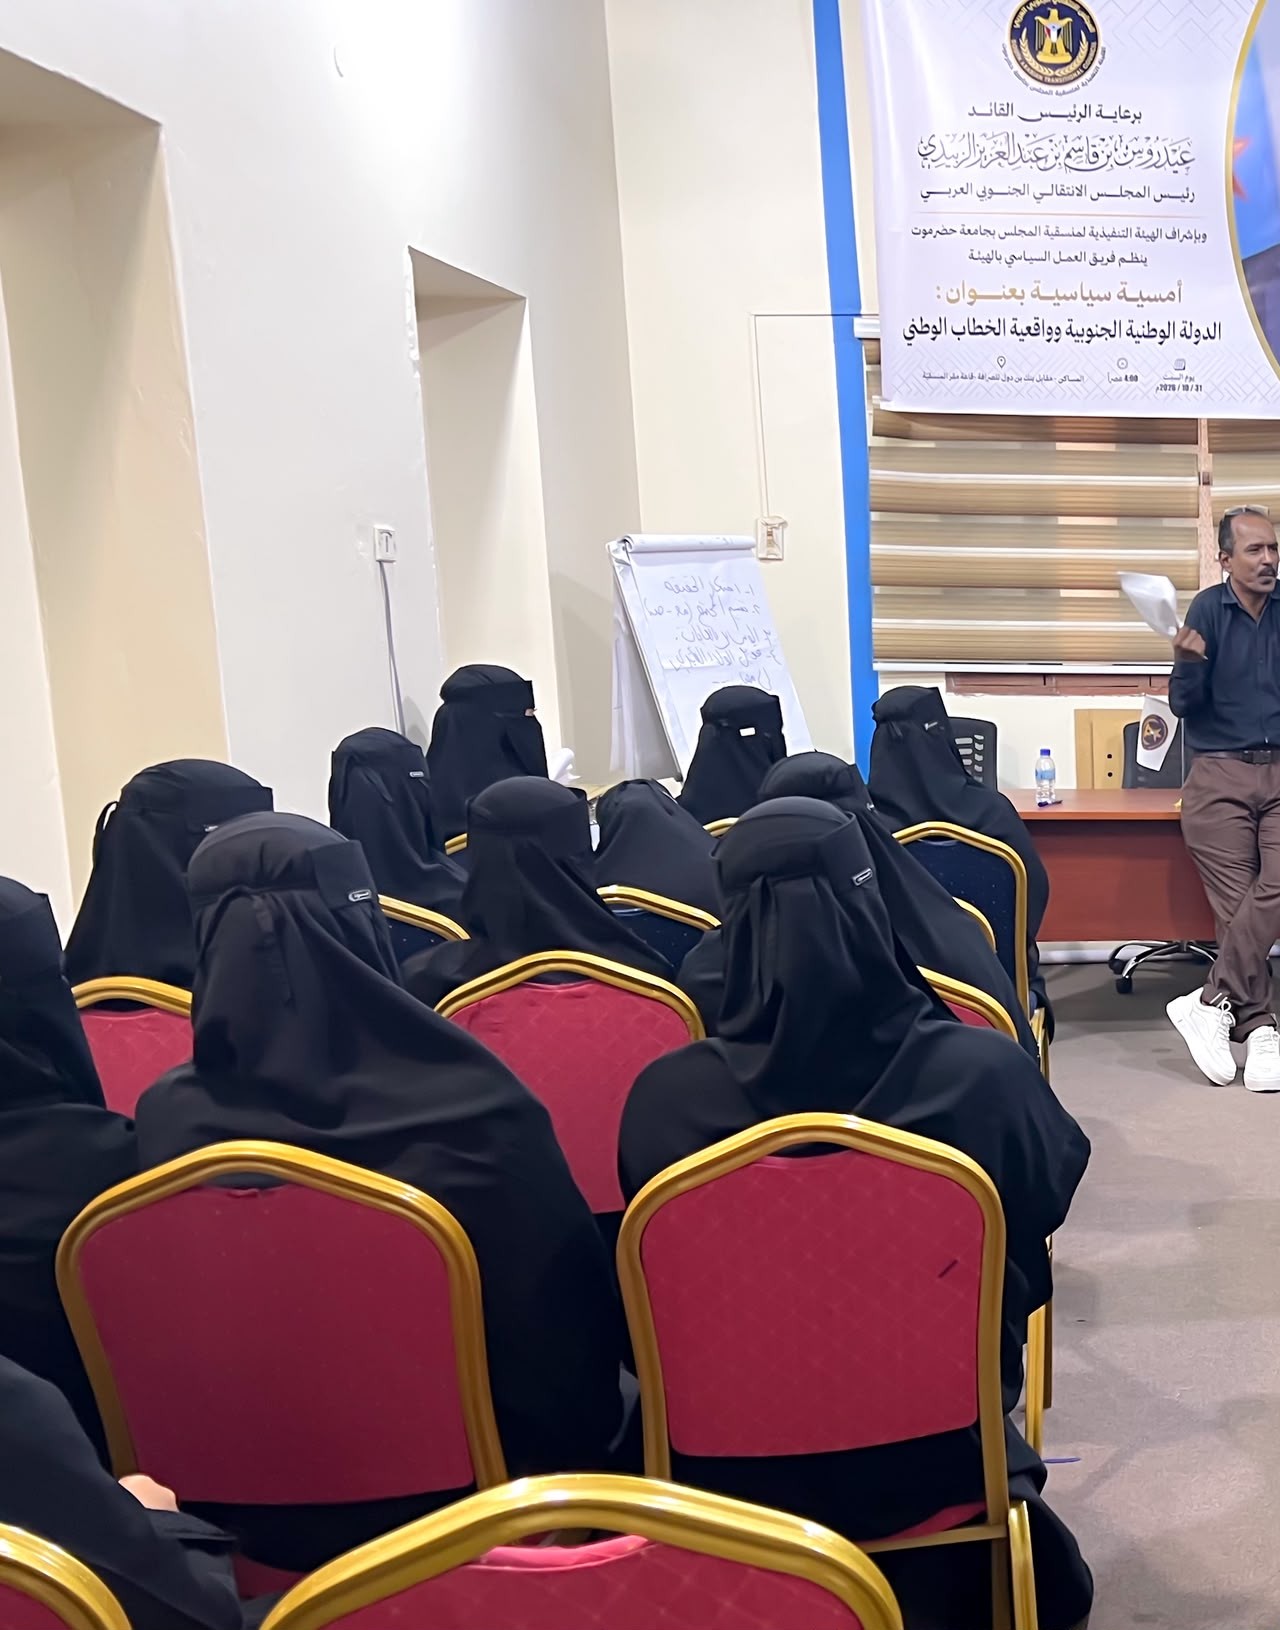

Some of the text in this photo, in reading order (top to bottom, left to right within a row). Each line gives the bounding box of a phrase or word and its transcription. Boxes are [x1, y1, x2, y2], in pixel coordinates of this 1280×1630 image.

[968, 101, 1142, 124] برعاية الرئيس القائد
[920, 182, 1196, 204] رئيس المجلس الانتقالي الجنوبي العربي
[911, 224, 1208, 244] وبإشراف الهيئة التنفيذية لمنسقية المجلس بجامعة حضرموت
[968, 248, 1149, 268] ينظم فريق العمل السياسي بالهيئة
[946, 279, 1026, 306] بعنوان
[1030, 279, 1112, 307] سياسية
[1117, 279, 1183, 308] أمسية
[903, 316, 1222, 346] الدولة الوطنية الجنوبية وواقعية الخطاب الوطني
